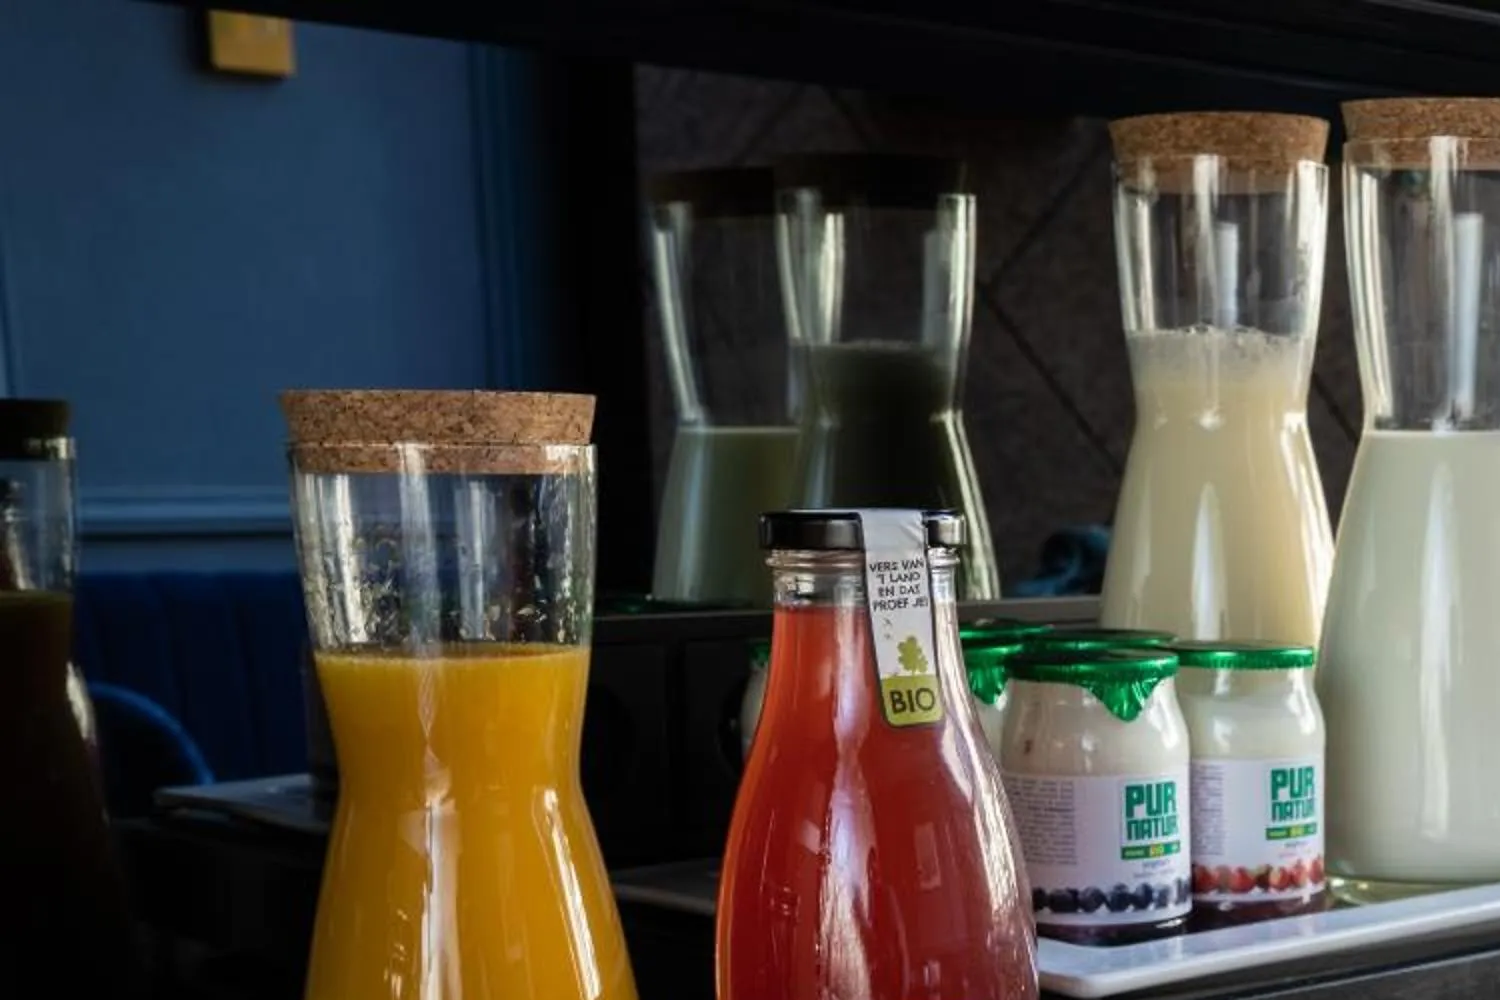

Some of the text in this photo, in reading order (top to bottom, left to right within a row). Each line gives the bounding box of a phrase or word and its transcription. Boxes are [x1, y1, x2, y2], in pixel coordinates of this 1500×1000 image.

[869, 558, 925, 572] VERS VAN
[889, 571, 921, 582] LAND
[878, 584, 921, 597] EN DAT
[872, 597, 909, 611] PROEF
[889, 687, 936, 714] BIO
[1271, 766, 1315, 801] PUR
[1125, 781, 1176, 819] PUR
